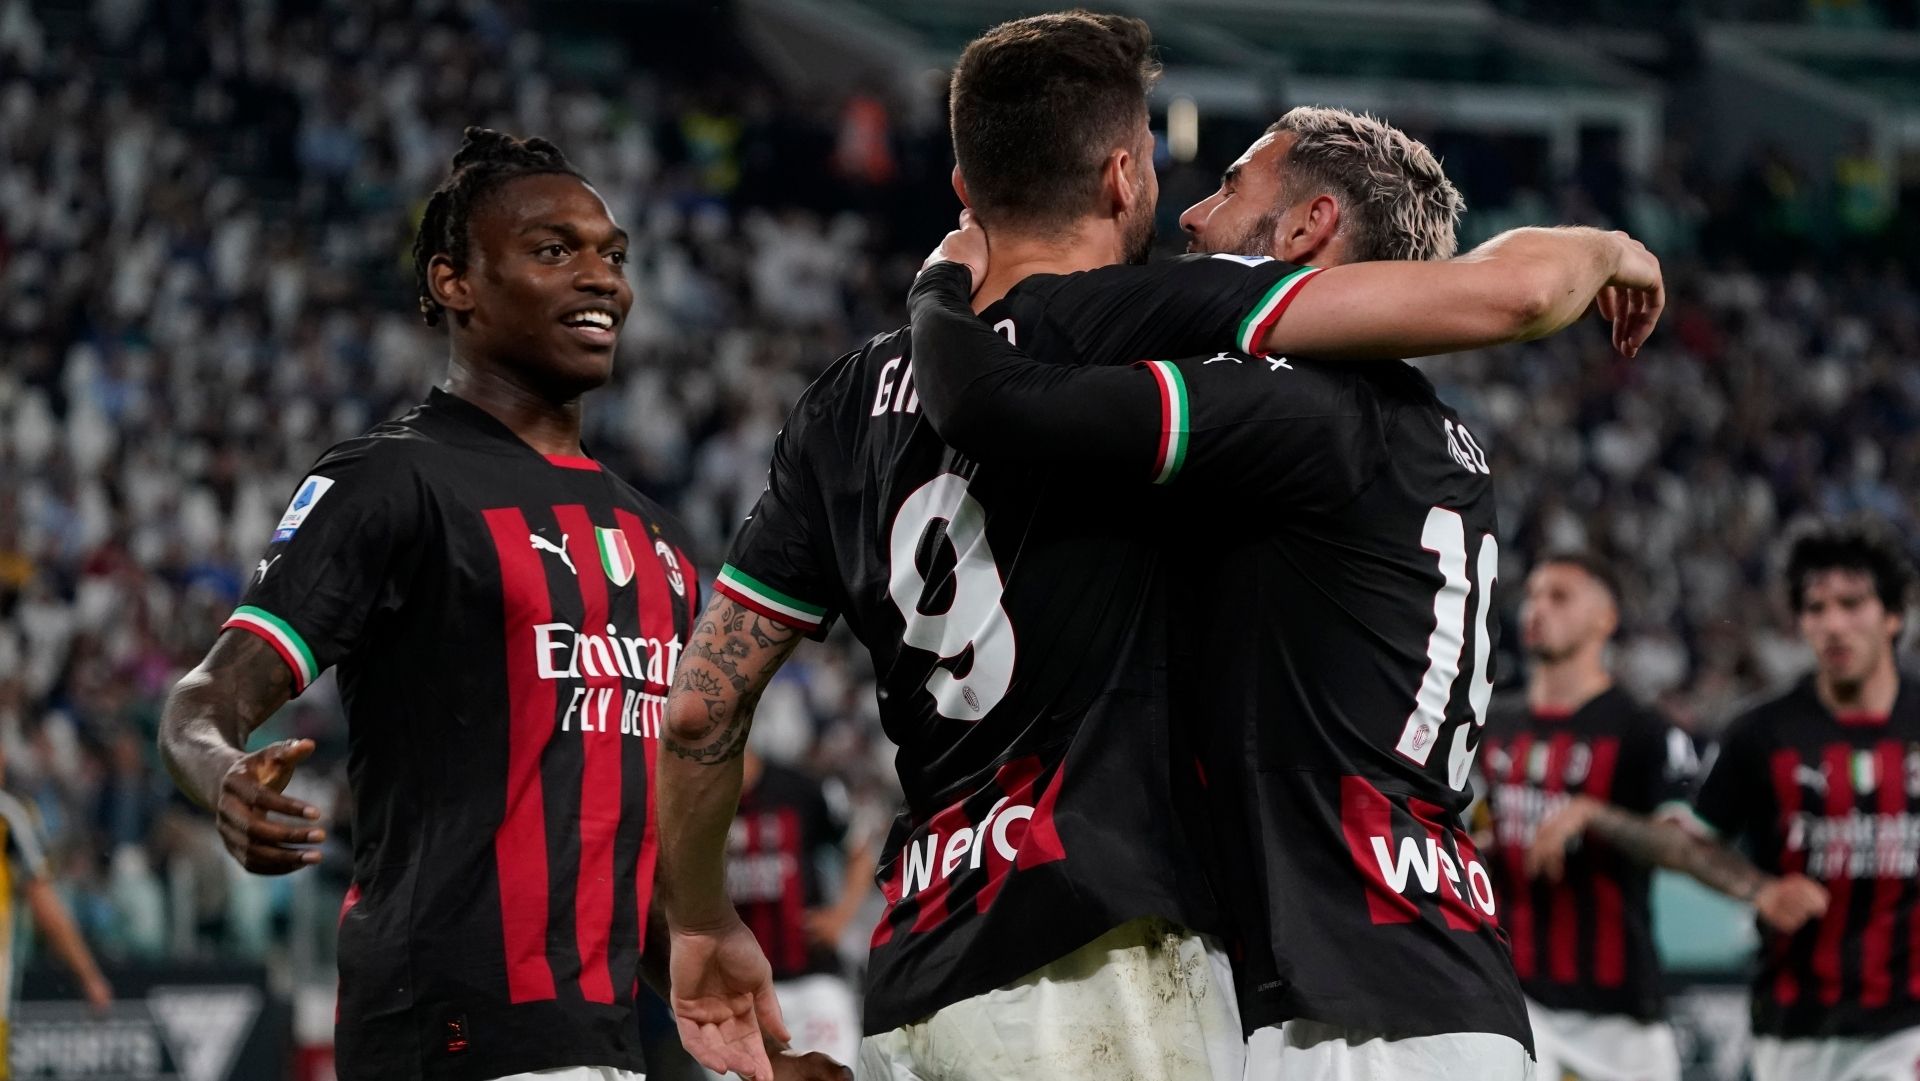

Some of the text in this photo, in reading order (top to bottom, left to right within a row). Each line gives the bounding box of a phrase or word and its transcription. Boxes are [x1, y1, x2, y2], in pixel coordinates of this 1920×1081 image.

[890, 472, 1016, 721] 9
[533, 622, 683, 687] Emirat
[1395, 506, 1499, 792] 19
[562, 687, 668, 739] FLY BETT
[902, 796, 1035, 898] wefo
[1370, 836, 1496, 916] weo
